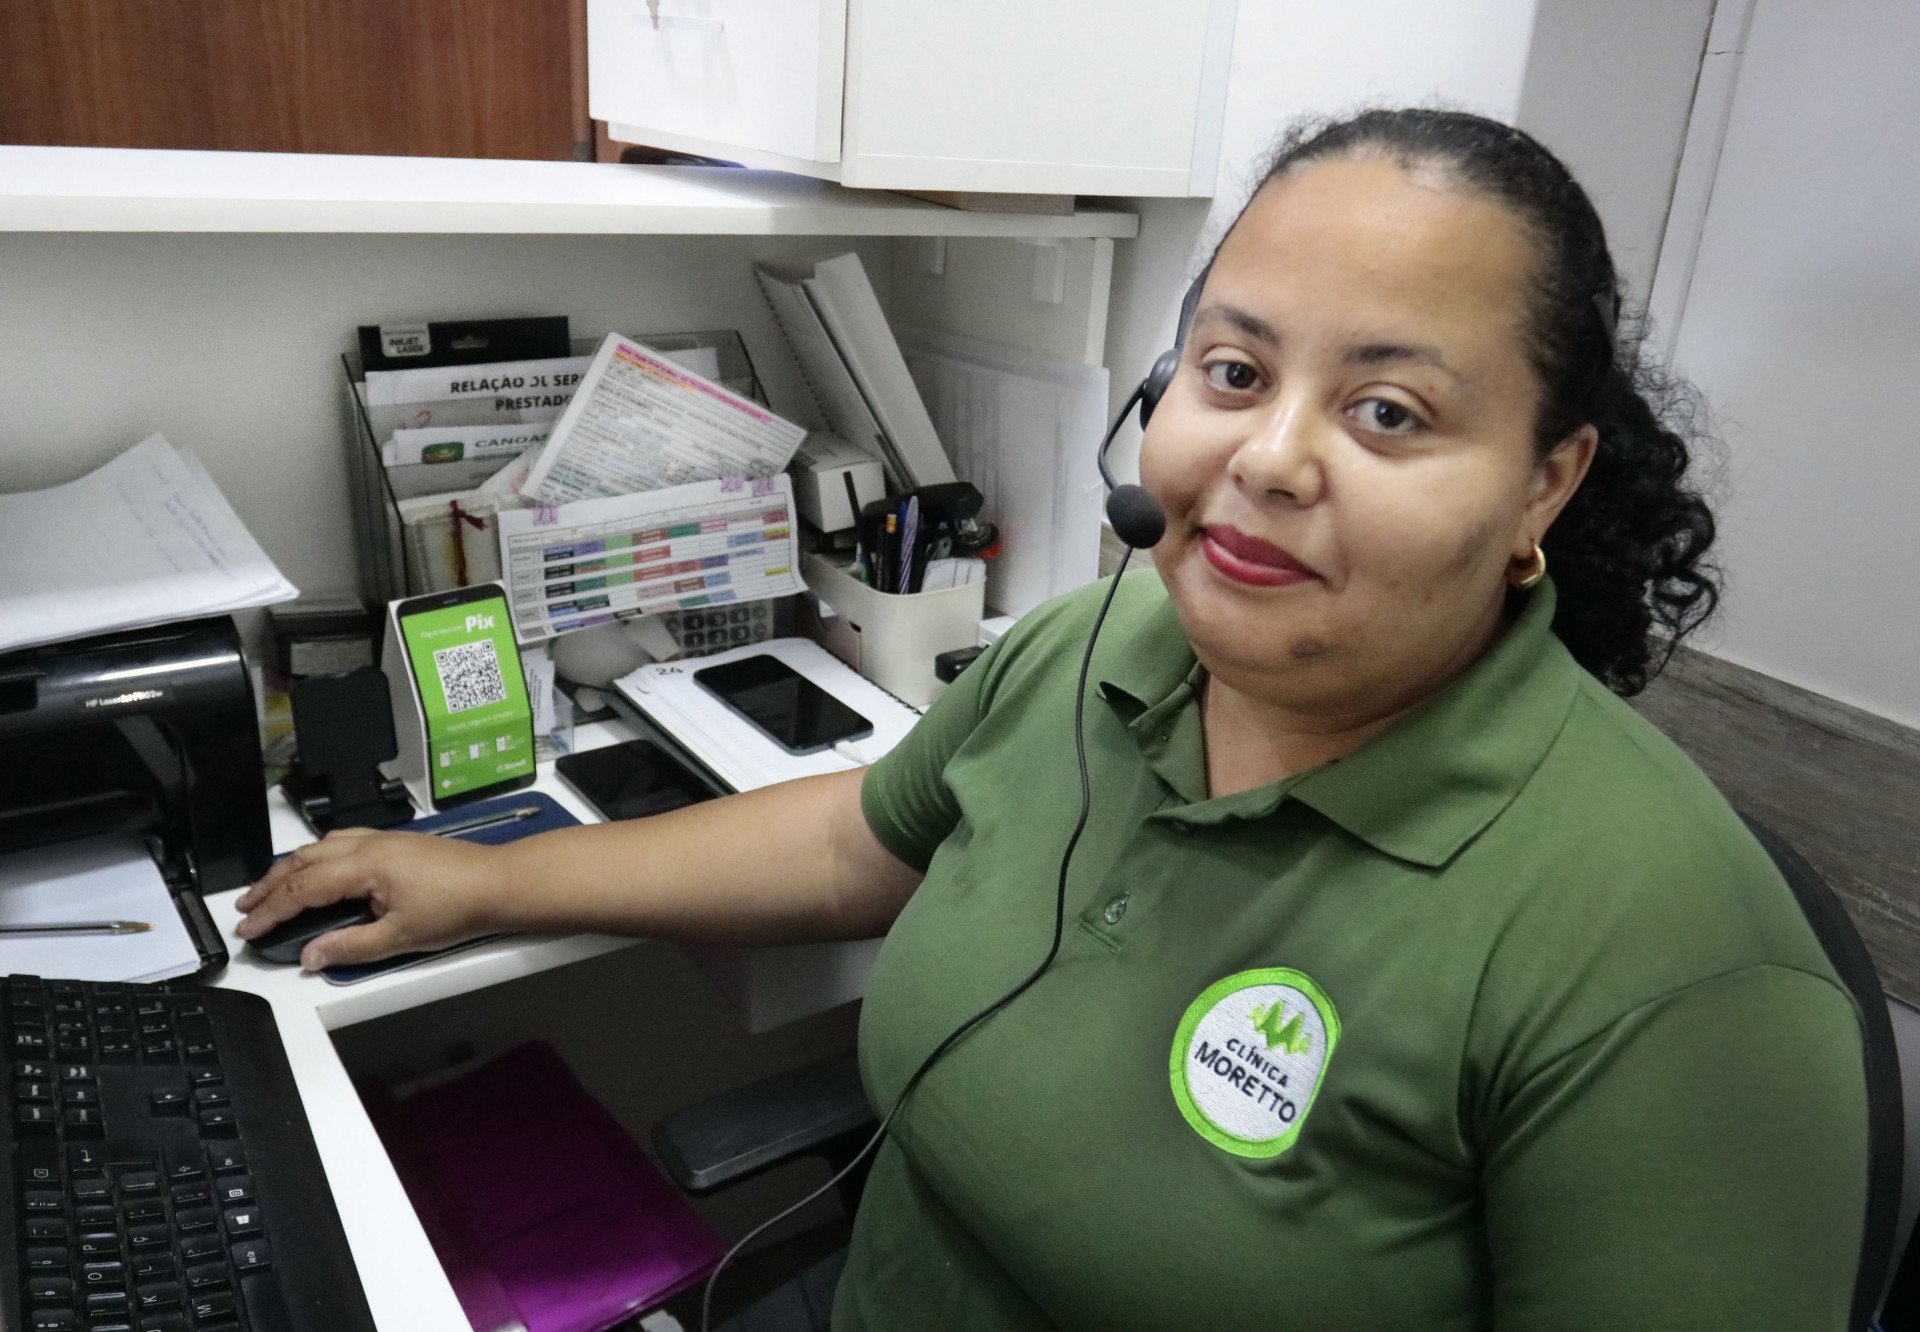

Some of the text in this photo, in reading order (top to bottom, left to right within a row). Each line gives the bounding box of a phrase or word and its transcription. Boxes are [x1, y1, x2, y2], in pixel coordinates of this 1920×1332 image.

[465, 613, 496, 633] Pix
[86, 699, 98, 707] HP
[1226, 1038, 1291, 1087] CLÍNICA
[1193, 1041, 1296, 1124] MORETTO
